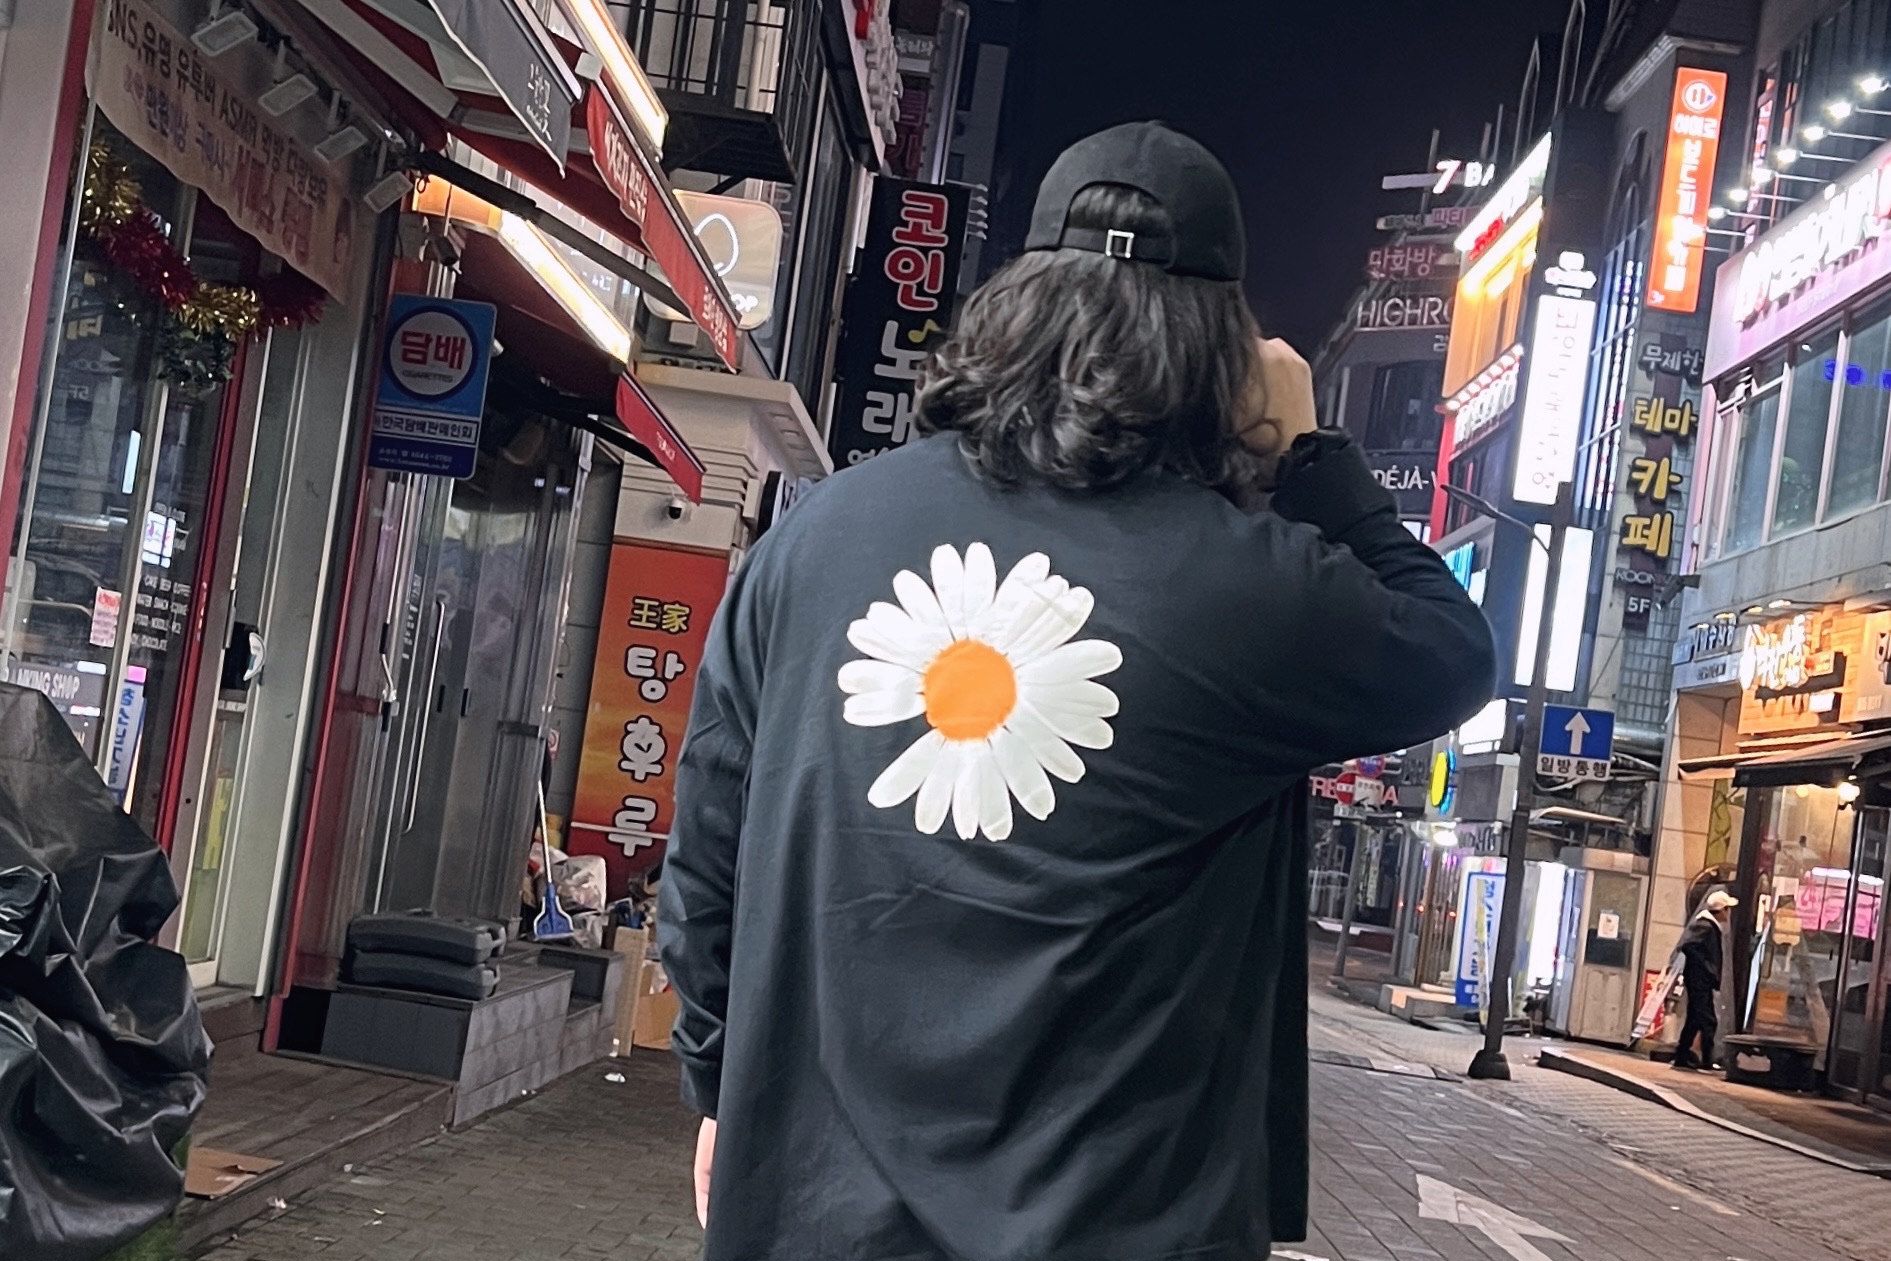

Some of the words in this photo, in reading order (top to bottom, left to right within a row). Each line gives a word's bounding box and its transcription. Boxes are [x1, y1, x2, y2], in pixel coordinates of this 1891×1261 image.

[176, 47, 217, 118] 유튜버
[1433, 159, 1462, 194] 7
[401, 330, 467, 370] 담배
[1633, 397, 1699, 436] 테마
[628, 596, 691, 634] 王家
[1627, 596, 1651, 613] 5F
[607, 645, 687, 858] 탕후루
[1541, 756, 1608, 778] 일방통행
